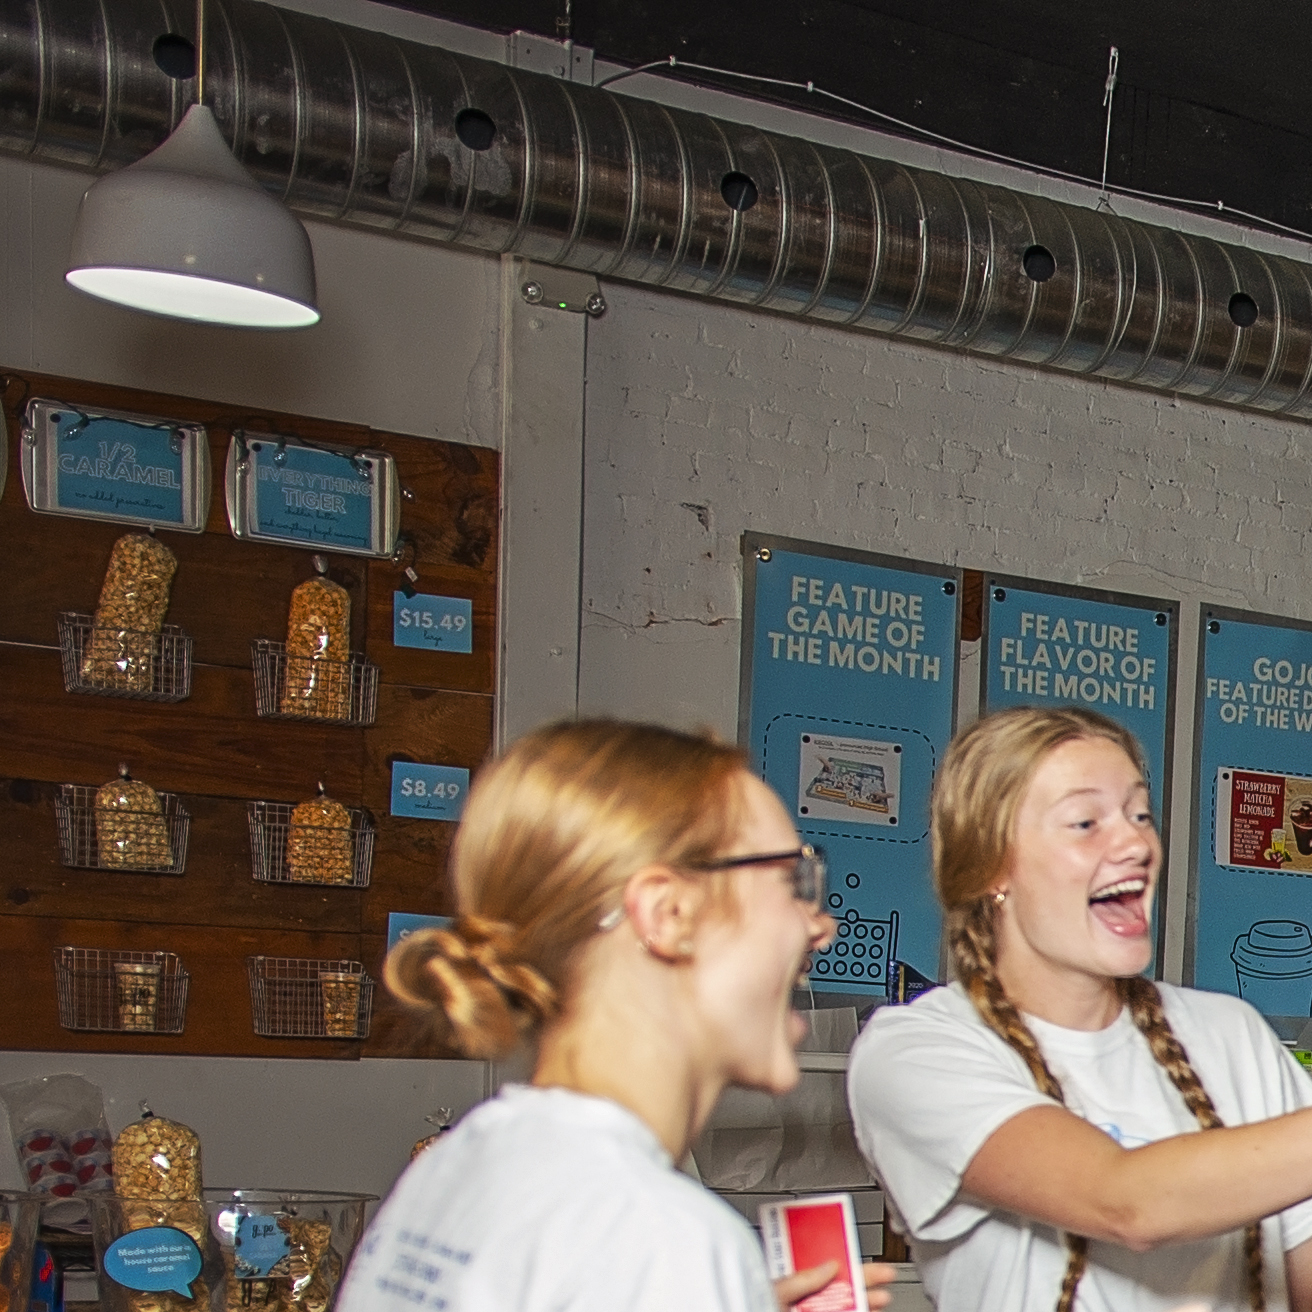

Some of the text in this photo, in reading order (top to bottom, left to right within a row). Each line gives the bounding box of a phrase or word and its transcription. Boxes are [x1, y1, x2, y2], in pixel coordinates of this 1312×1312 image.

[98, 440, 136, 463] 1/2
[58, 453, 181, 490] CARAMEL
[257, 465, 372, 497] EVERYTHING
[281, 487, 347, 514] TIGER
[791, 575, 923, 622] FEATURE
[399, 608, 467, 632] $15.49
[787, 605, 925, 650] GAME OF
[1020, 612, 1138, 653] FEATURE
[768, 631, 940, 682] THE MONTH
[1001, 637, 1156, 682] FLAVOR OF
[1000, 665, 1155, 710] THE MONTH
[1206, 678, 1299, 709] FEATURE
[1219, 702, 1250, 724] OF
[1253, 706, 1290, 730] THE
[401, 777, 460, 799] $8.49
[1235, 780, 1281, 795] STRAWBERRY
[1243, 792, 1273, 806] MATCHA
[1239, 803, 1275, 817] LEMONADE
[118, 1247, 146, 1257] Made
